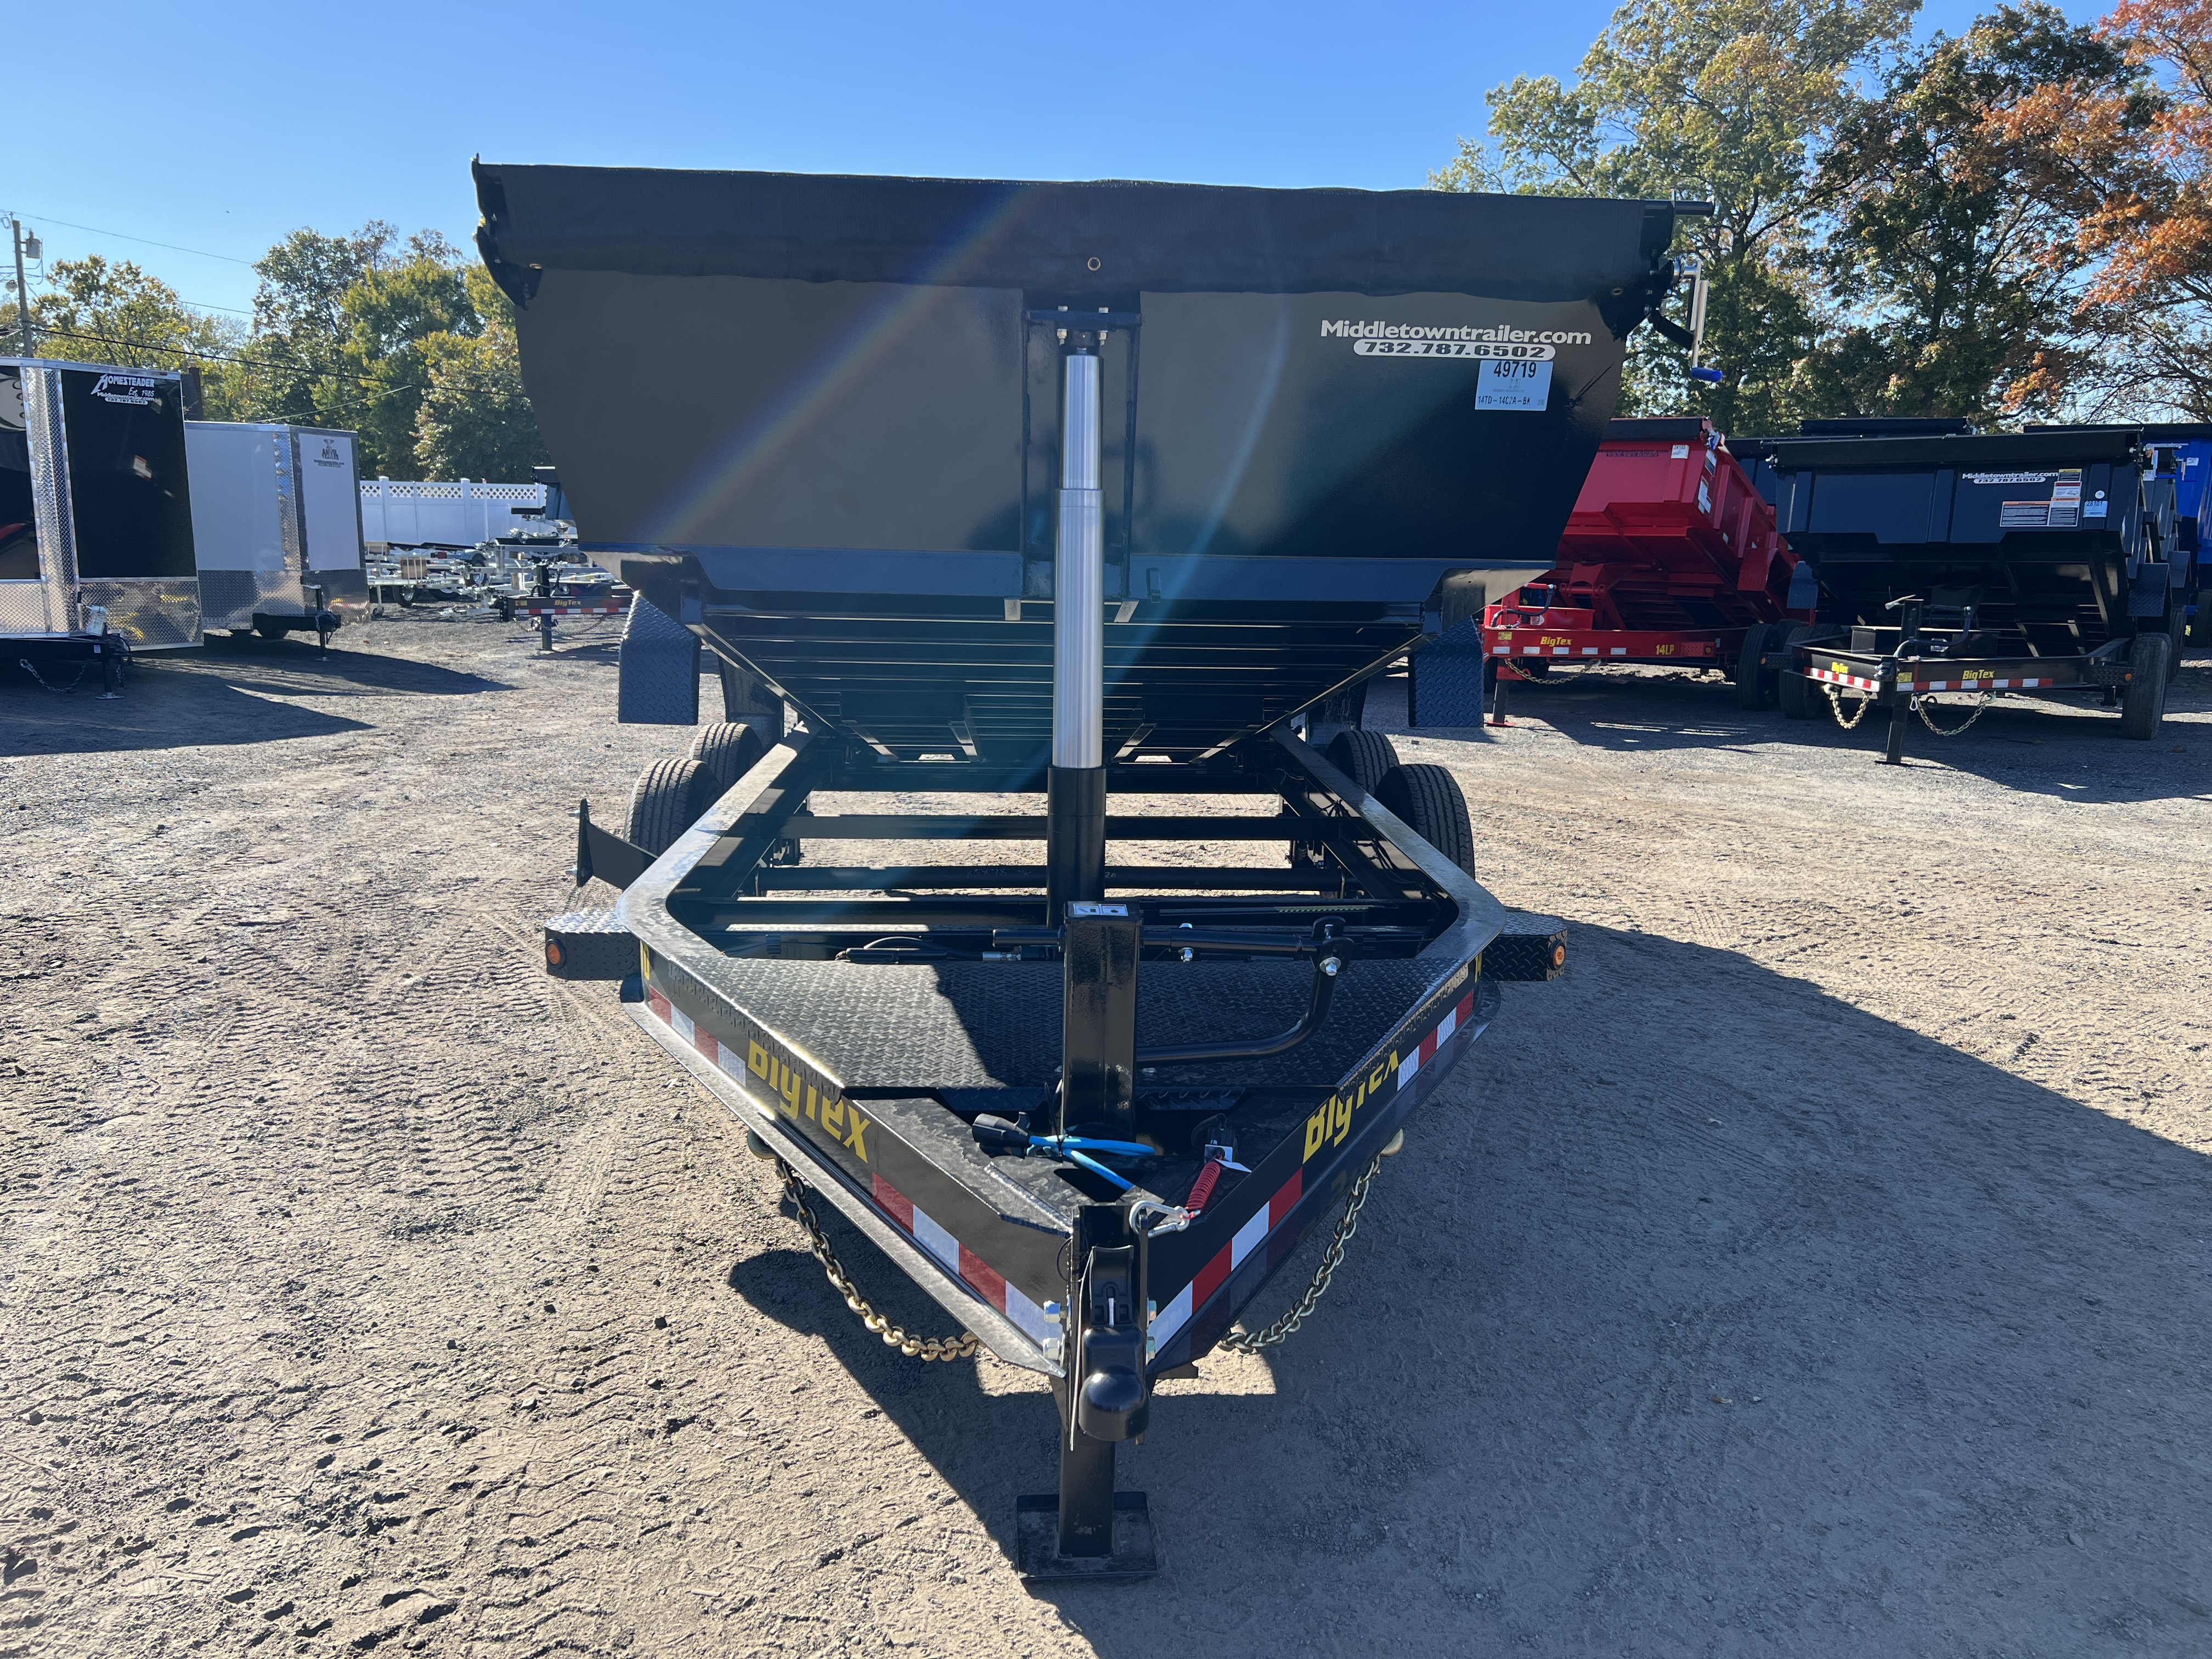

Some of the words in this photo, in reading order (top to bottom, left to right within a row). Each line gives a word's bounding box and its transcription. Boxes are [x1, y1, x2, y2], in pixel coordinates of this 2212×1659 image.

[1320, 319, 1592, 345] Middletowntrailer.com
[1364, 341, 1546, 358] 732.787.6502
[1493, 360, 1537, 378] 49719
[90, 373, 155, 395] HOMESTEADER
[1962, 471, 2059, 479] Middletowntrailer.com
[554, 599, 582, 607] BigTex
[1540, 636, 1572, 647] BigTex
[1655, 644, 1675, 656] 14LP
[1962, 669, 1995, 681] BigTex
